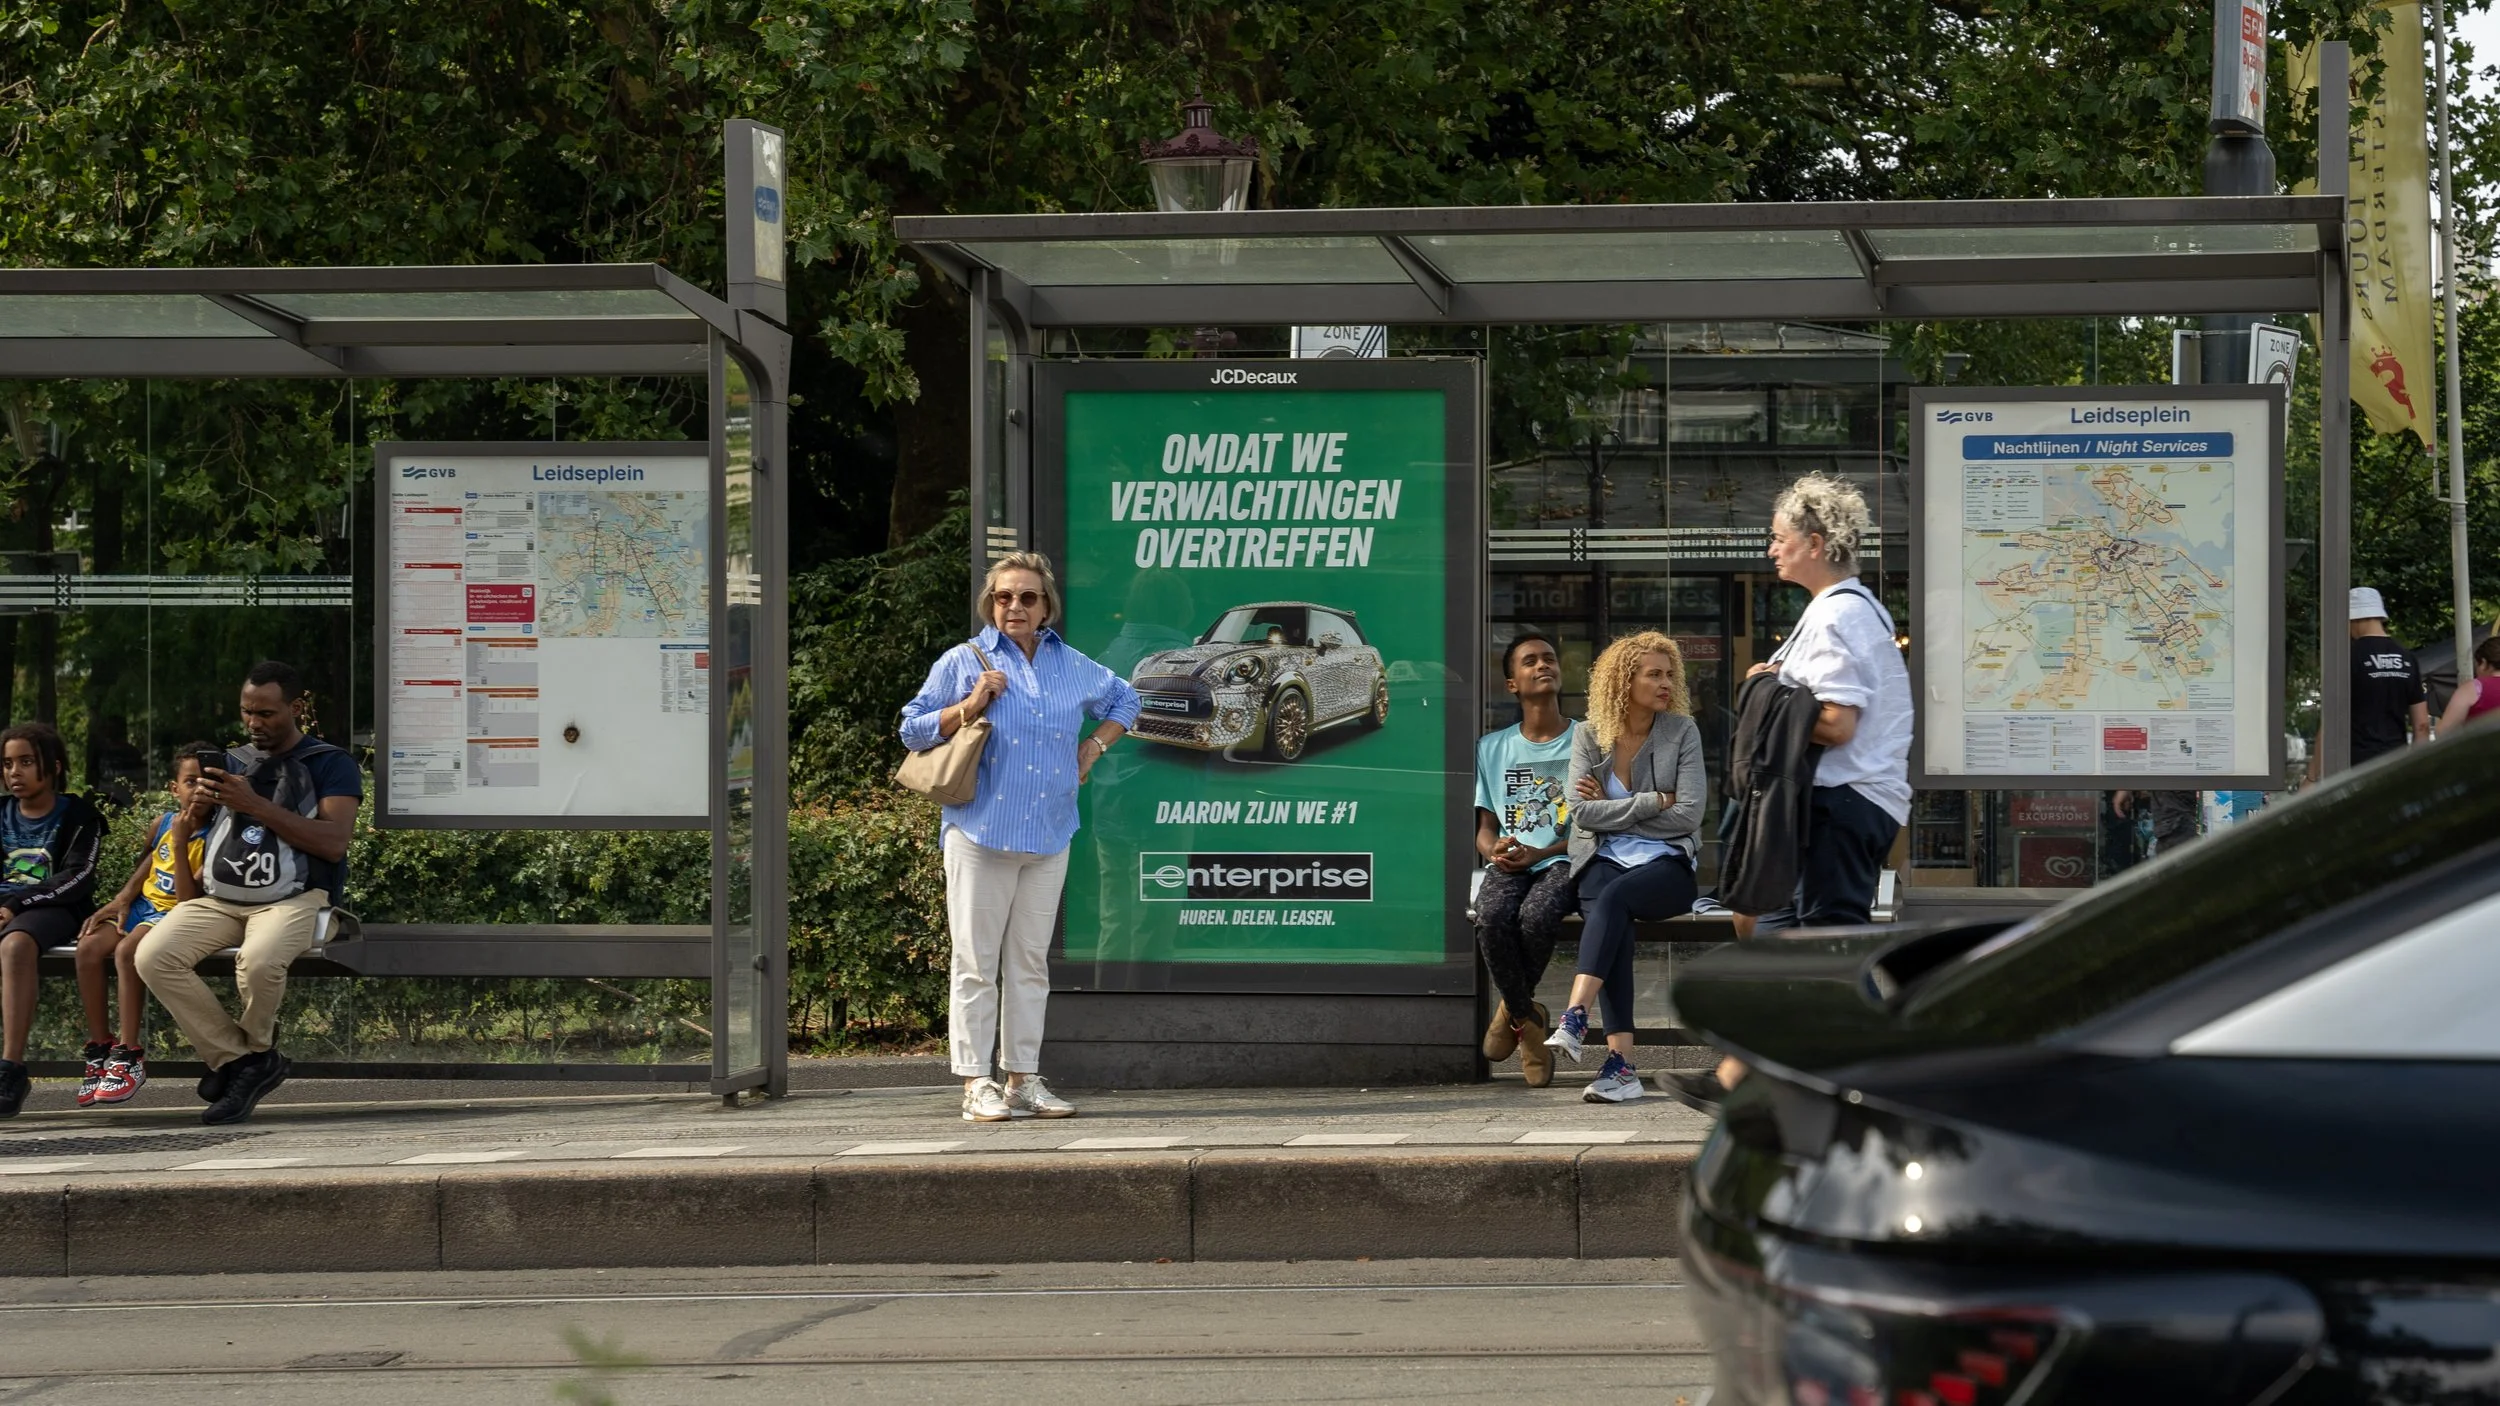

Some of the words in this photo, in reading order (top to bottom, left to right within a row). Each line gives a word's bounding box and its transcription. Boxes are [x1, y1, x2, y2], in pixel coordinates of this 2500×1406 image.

[1323, 326, 1361, 341] ZONE
[2270, 339, 2290, 354] ZONE
[1210, 369, 1297, 385] JCDecaux
[1965, 411, 1993, 422] GVB
[2070, 406, 2191, 426] Leidseplein
[1162, 433, 1282, 474] OMDAT
[1292, 432, 1348, 473] WE
[1993, 440, 2080, 457] Nachtlijnen
[2084, 440, 2091, 454] /
[2095, 439, 2138, 457] Night
[2142, 439, 2208, 454] Services
[429, 468, 456, 478] GVB
[533, 464, 644, 484] Leidseplein
[1111, 480, 1402, 521] VERWACHTINGEN
[1135, 527, 1374, 568] OVERTREFFEN
[2369, 653, 2404, 669] VANS
[1143, 700, 1186, 711] enterprise
[1155, 801, 1241, 824] DAAROM
[1244, 801, 1290, 824] ZIJN
[1296, 801, 1328, 824] WE
[1331, 801, 1358, 824] #1
[2018, 812, 2090, 821] EXCURSIONS
[244, 851, 276, 886] 29
[1150, 861, 1369, 894] enterprise
[156, 873, 176, 892] FO
[1179, 909, 1228, 926] HUREN.
[1231, 909, 1278, 926] DELEN.
[1281, 909, 1336, 926] LEASEN.
